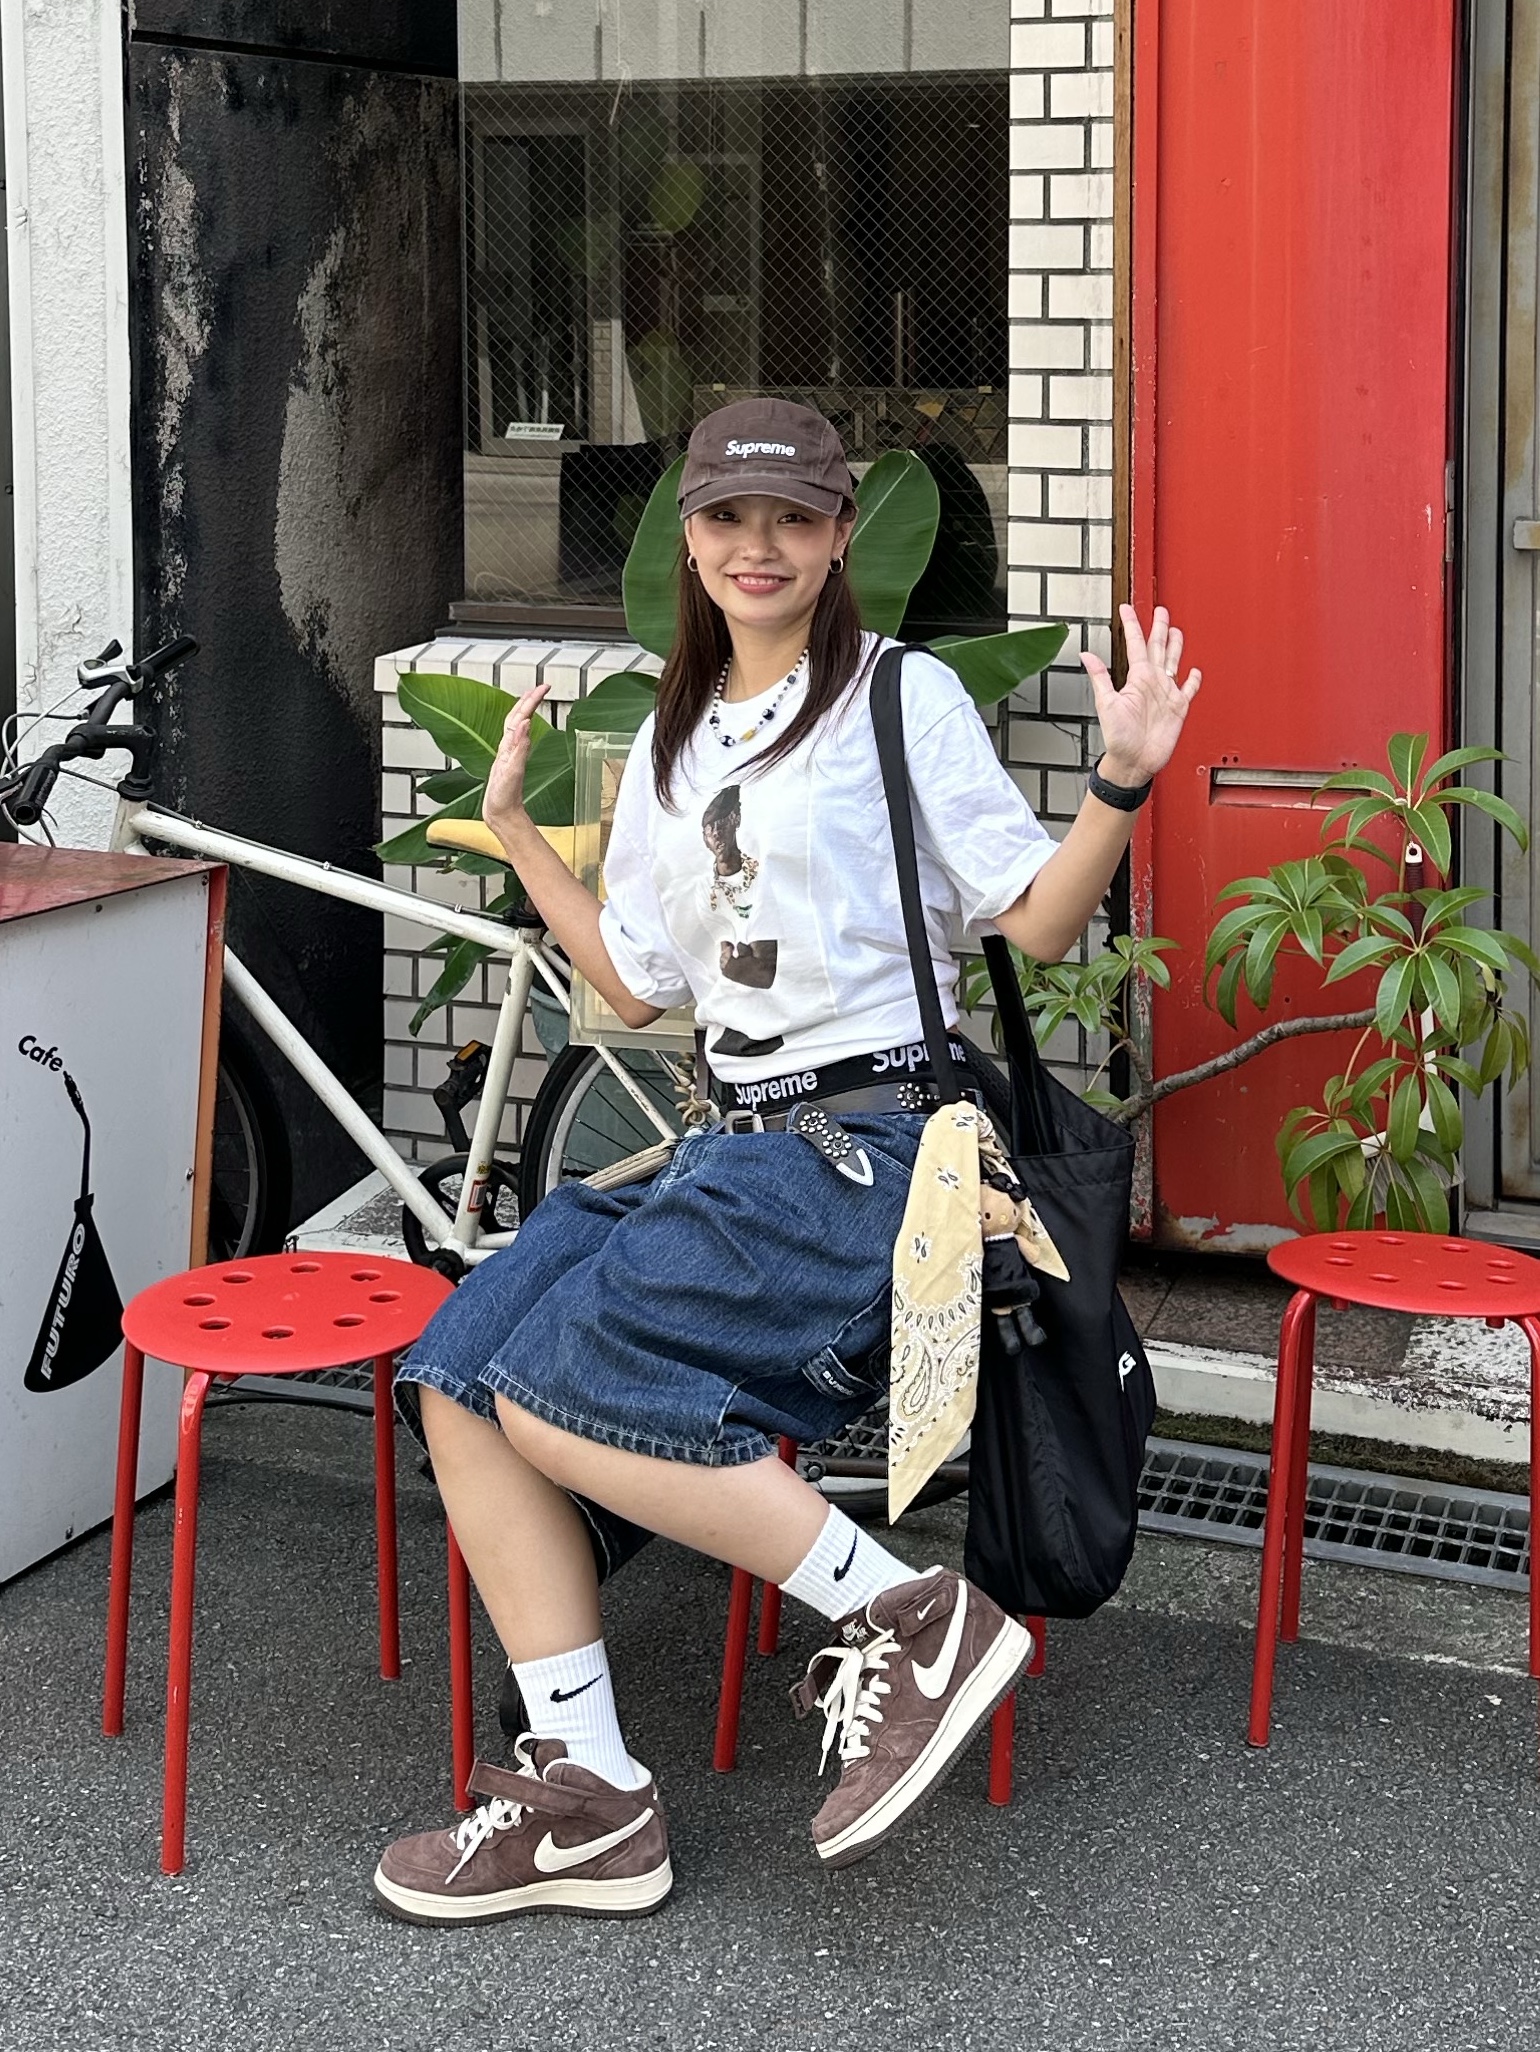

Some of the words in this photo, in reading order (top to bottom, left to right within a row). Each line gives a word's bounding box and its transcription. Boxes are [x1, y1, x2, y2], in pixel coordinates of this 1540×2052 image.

[725, 440, 796, 459] Supreme
[18, 1035, 63, 1072] Cafe
[735, 1070, 818, 1112] Supreme
[41, 1223, 85, 1380] FUTURO
